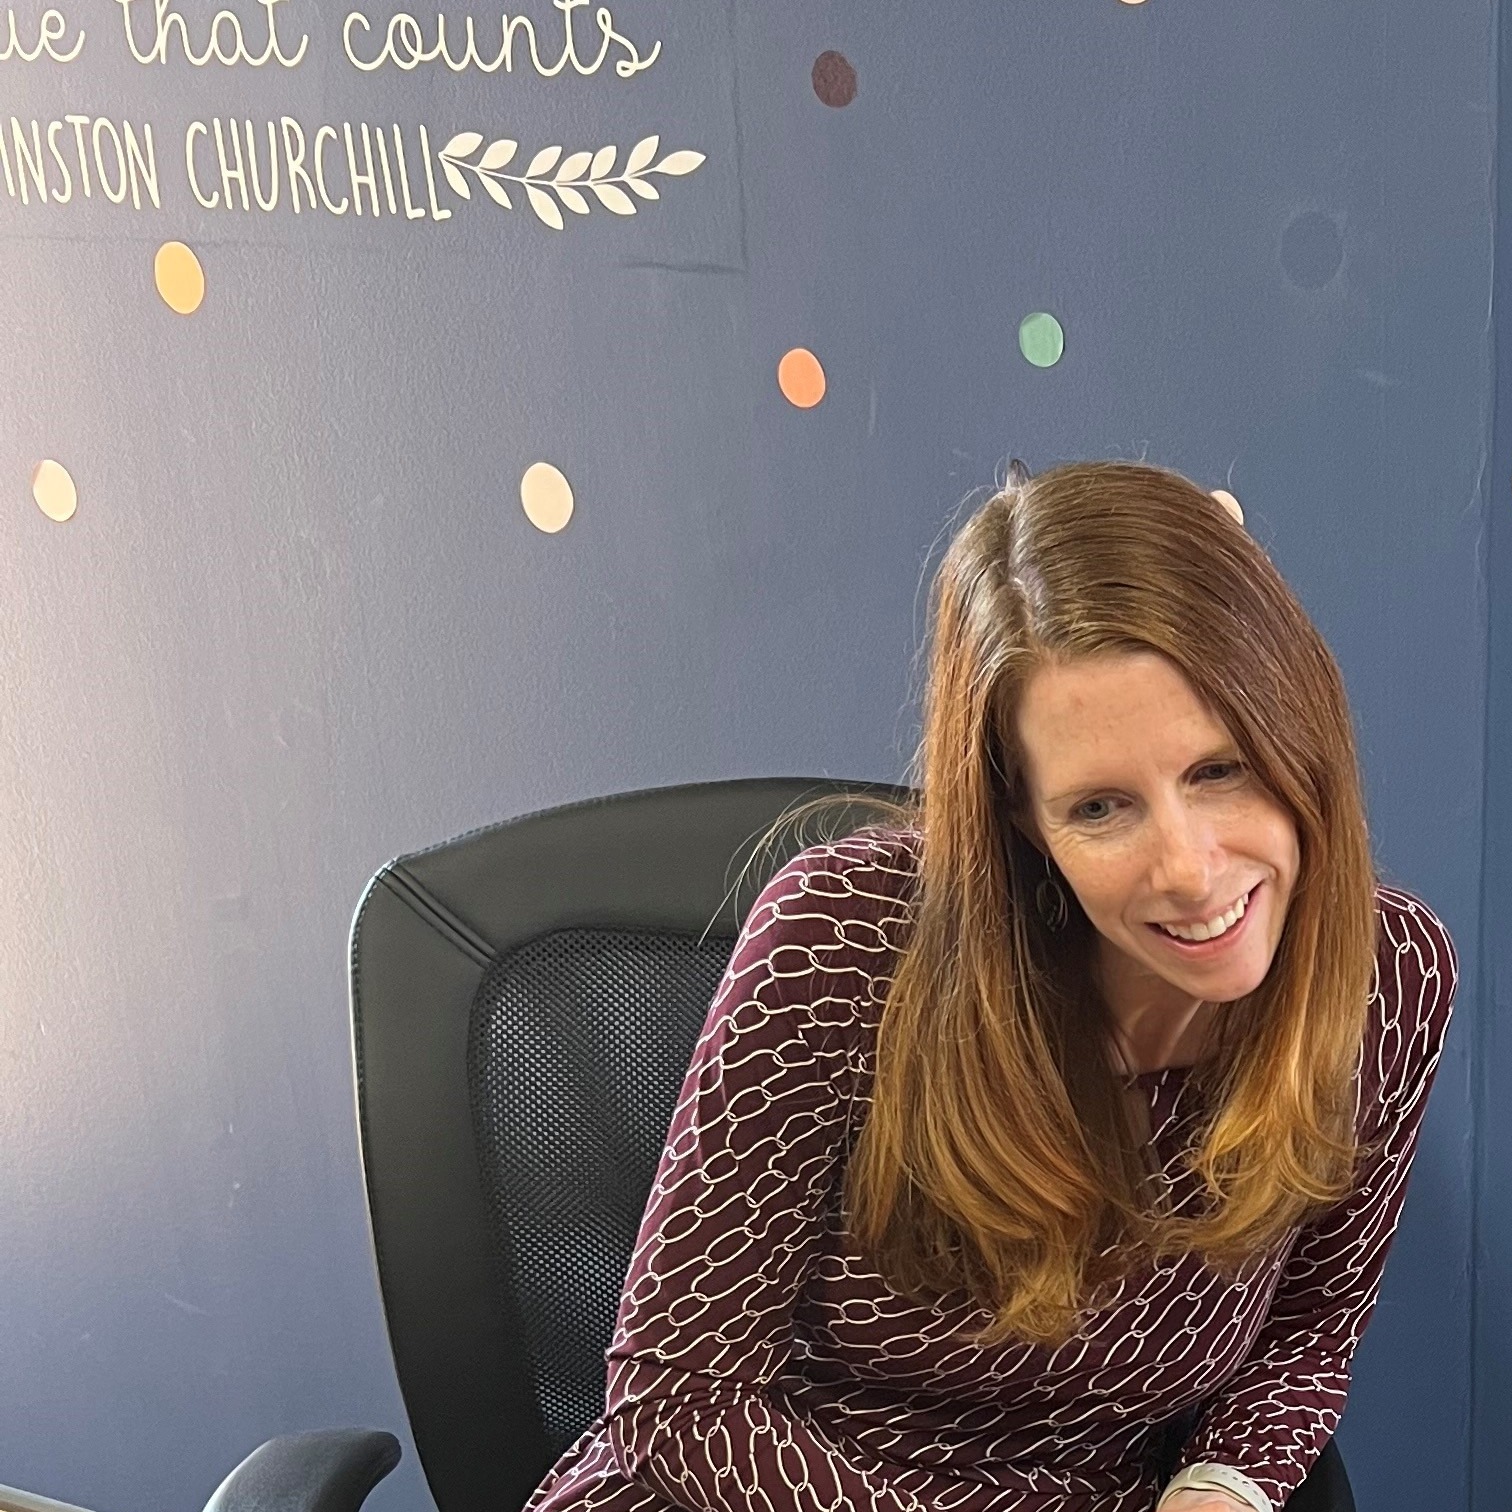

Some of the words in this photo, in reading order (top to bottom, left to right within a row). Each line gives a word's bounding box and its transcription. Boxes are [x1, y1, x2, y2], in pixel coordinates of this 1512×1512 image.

[115, 0, 308, 67] that
[343, 0, 661, 77] counts
[186, 115, 452, 220] CHURCHILL
